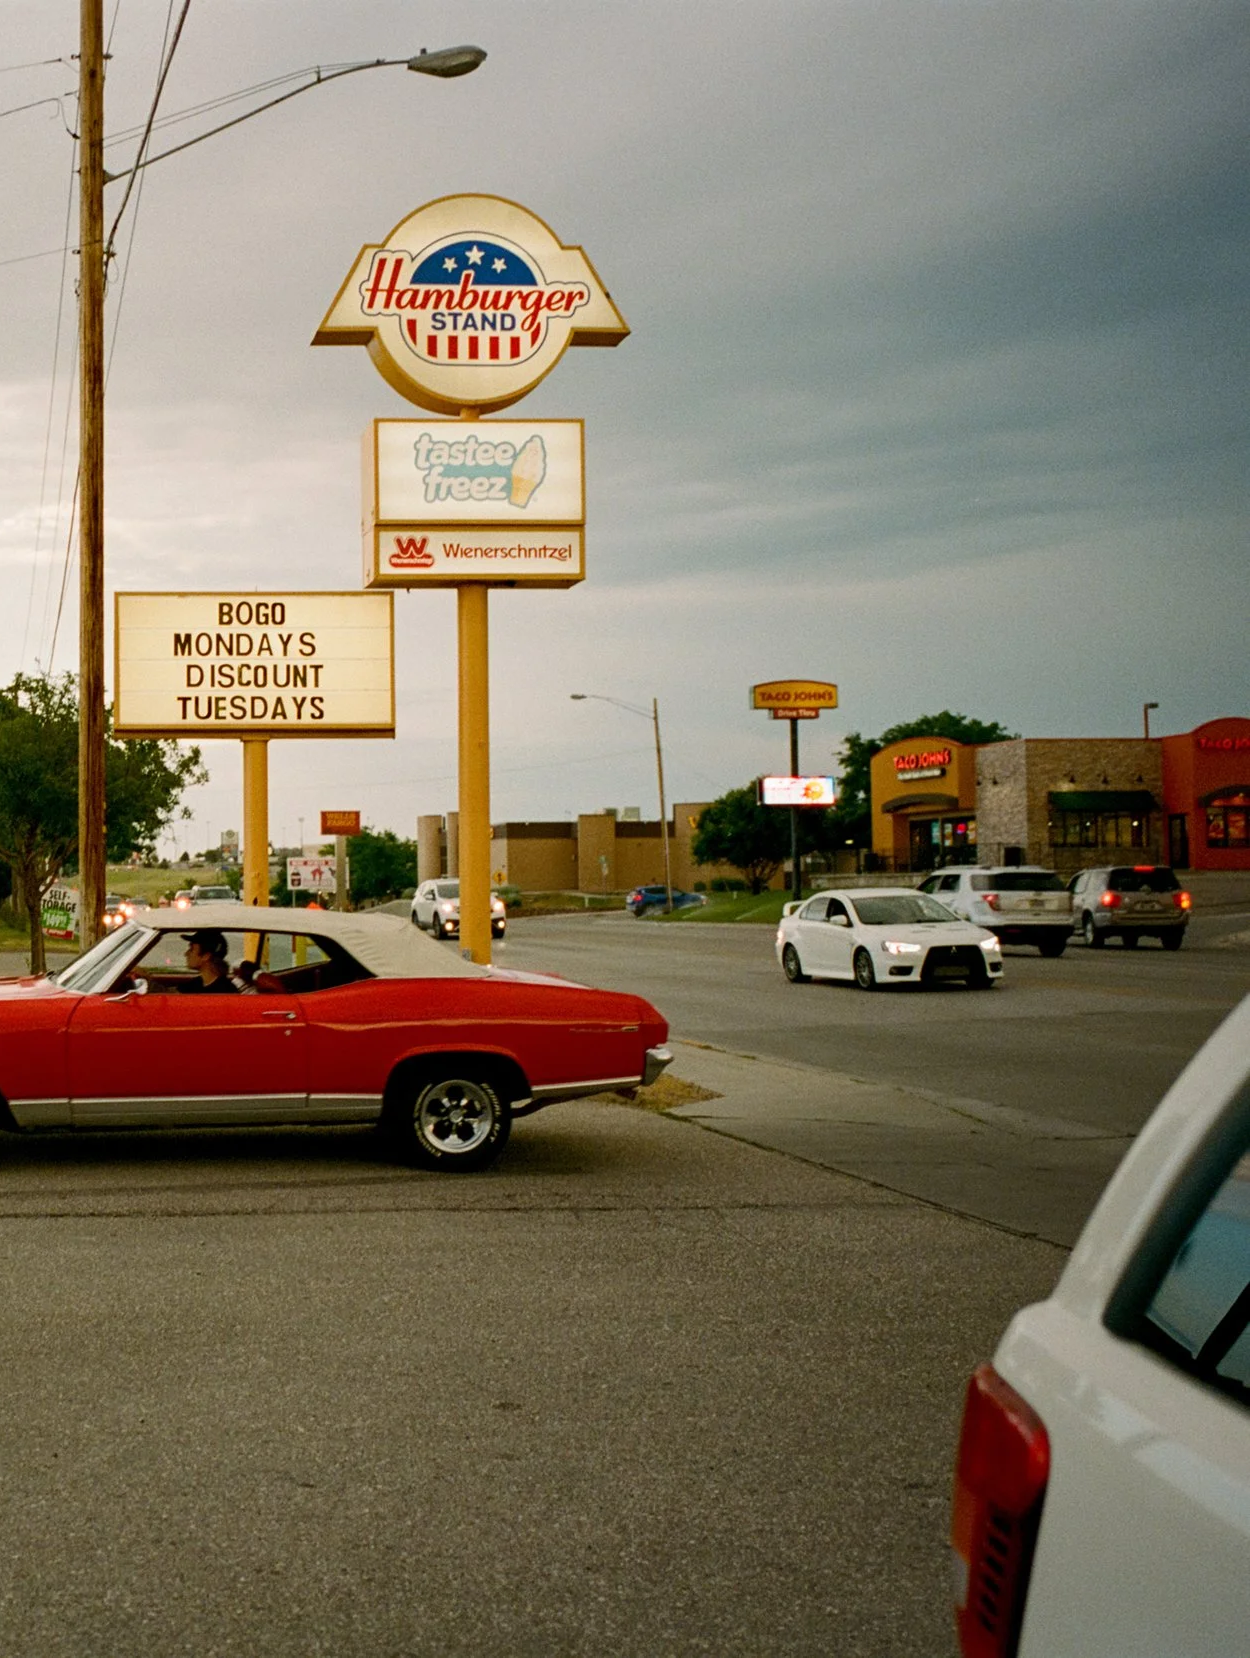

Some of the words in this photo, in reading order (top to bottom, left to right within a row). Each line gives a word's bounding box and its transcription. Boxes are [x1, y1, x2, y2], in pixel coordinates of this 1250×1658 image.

[365, 257, 585, 332] Hamburger
[431, 312, 517, 331] STAND
[414, 432, 517, 471] tastee
[423, 466, 509, 503] freez
[442, 543, 572, 561] Wienerschnitzel
[218, 601, 286, 626] BOGO
[173, 632, 316, 657] MONDAYS
[186, 663, 324, 688] DISCOUNT
[177, 695, 325, 720] TUESDAYS
[759, 691, 791, 702] TACO
[42, 899, 77, 912] TORAGE
